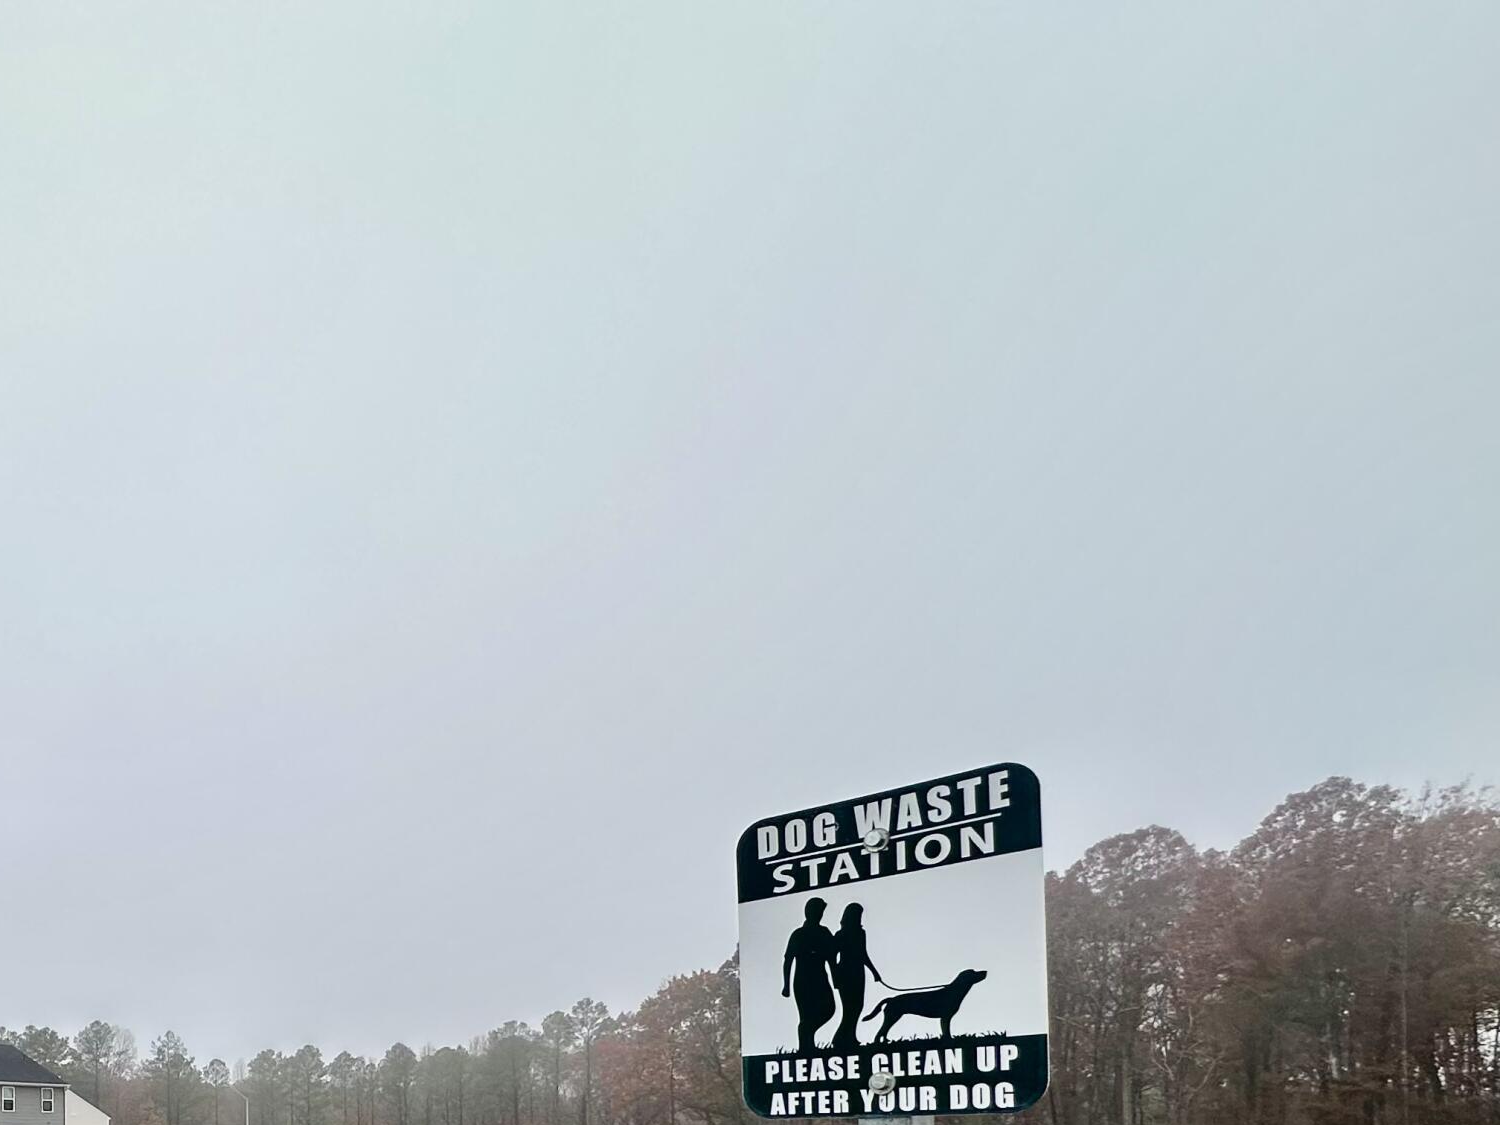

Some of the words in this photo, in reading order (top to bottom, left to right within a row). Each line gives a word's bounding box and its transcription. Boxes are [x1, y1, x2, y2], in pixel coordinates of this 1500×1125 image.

[757, 812, 840, 860] DOG
[853, 769, 1010, 839] WASTE
[772, 822, 996, 894] STATION
[765, 1054, 861, 1084] PLEASE
[871, 1047, 963, 1077] CLEAN
[976, 1044, 1020, 1073] UP
[770, 1090, 849, 1116] AFTER
[860, 1086, 937, 1113] YOUR
[950, 1082, 1015, 1109] DOG
